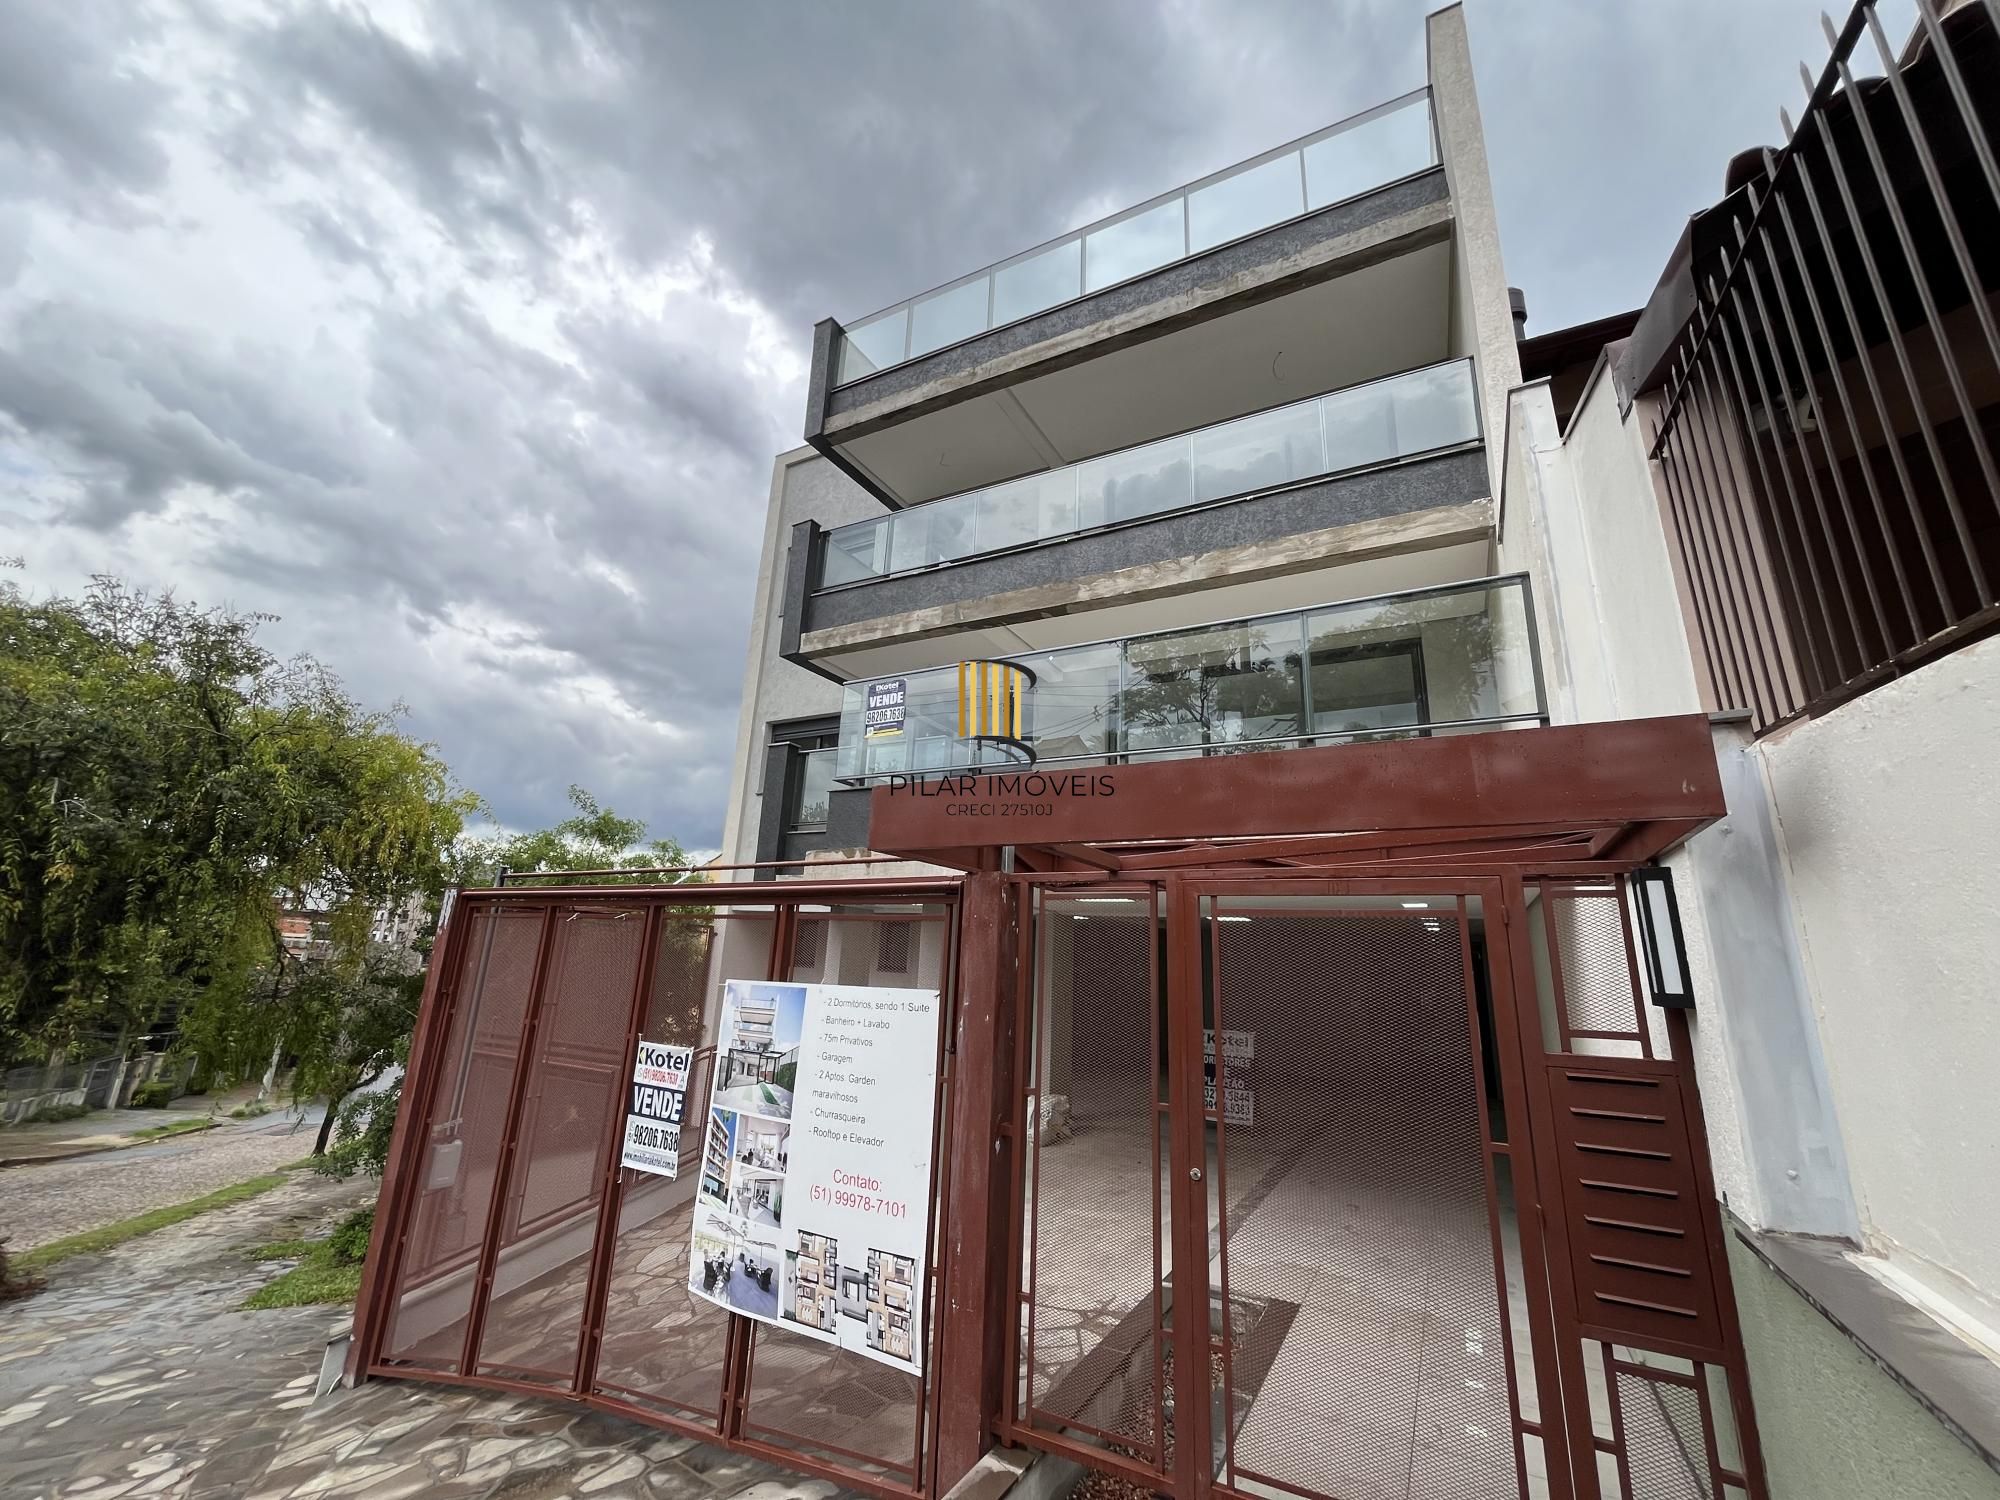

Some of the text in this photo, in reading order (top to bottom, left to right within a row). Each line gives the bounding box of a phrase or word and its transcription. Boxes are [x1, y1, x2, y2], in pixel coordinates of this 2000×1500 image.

[869, 692, 904, 708] VENDE
[827, 998, 833, 1007] 2
[875, 1001, 898, 1012] sendo
[901, 1002, 905, 1012] 1
[825, 1016, 855, 1027] Banheiro
[863, 1019, 890, 1030] Lavabo
[839, 1035, 873, 1047] Privativos
[644, 1047, 690, 1072] Kotel
[821, 1052, 853, 1065] Garagem
[824, 1071, 845, 1082] Aptos
[848, 1074, 876, 1086] Garden
[634, 1085, 683, 1122] VENDE
[814, 1107, 866, 1125] Churrasqueira
[633, 1124, 679, 1153] 98206.7638
[849, 1132, 885, 1148] Elevador
[833, 1168, 882, 1193] Contato:
[810, 1184, 906, 1219] (51) 99978-7101
